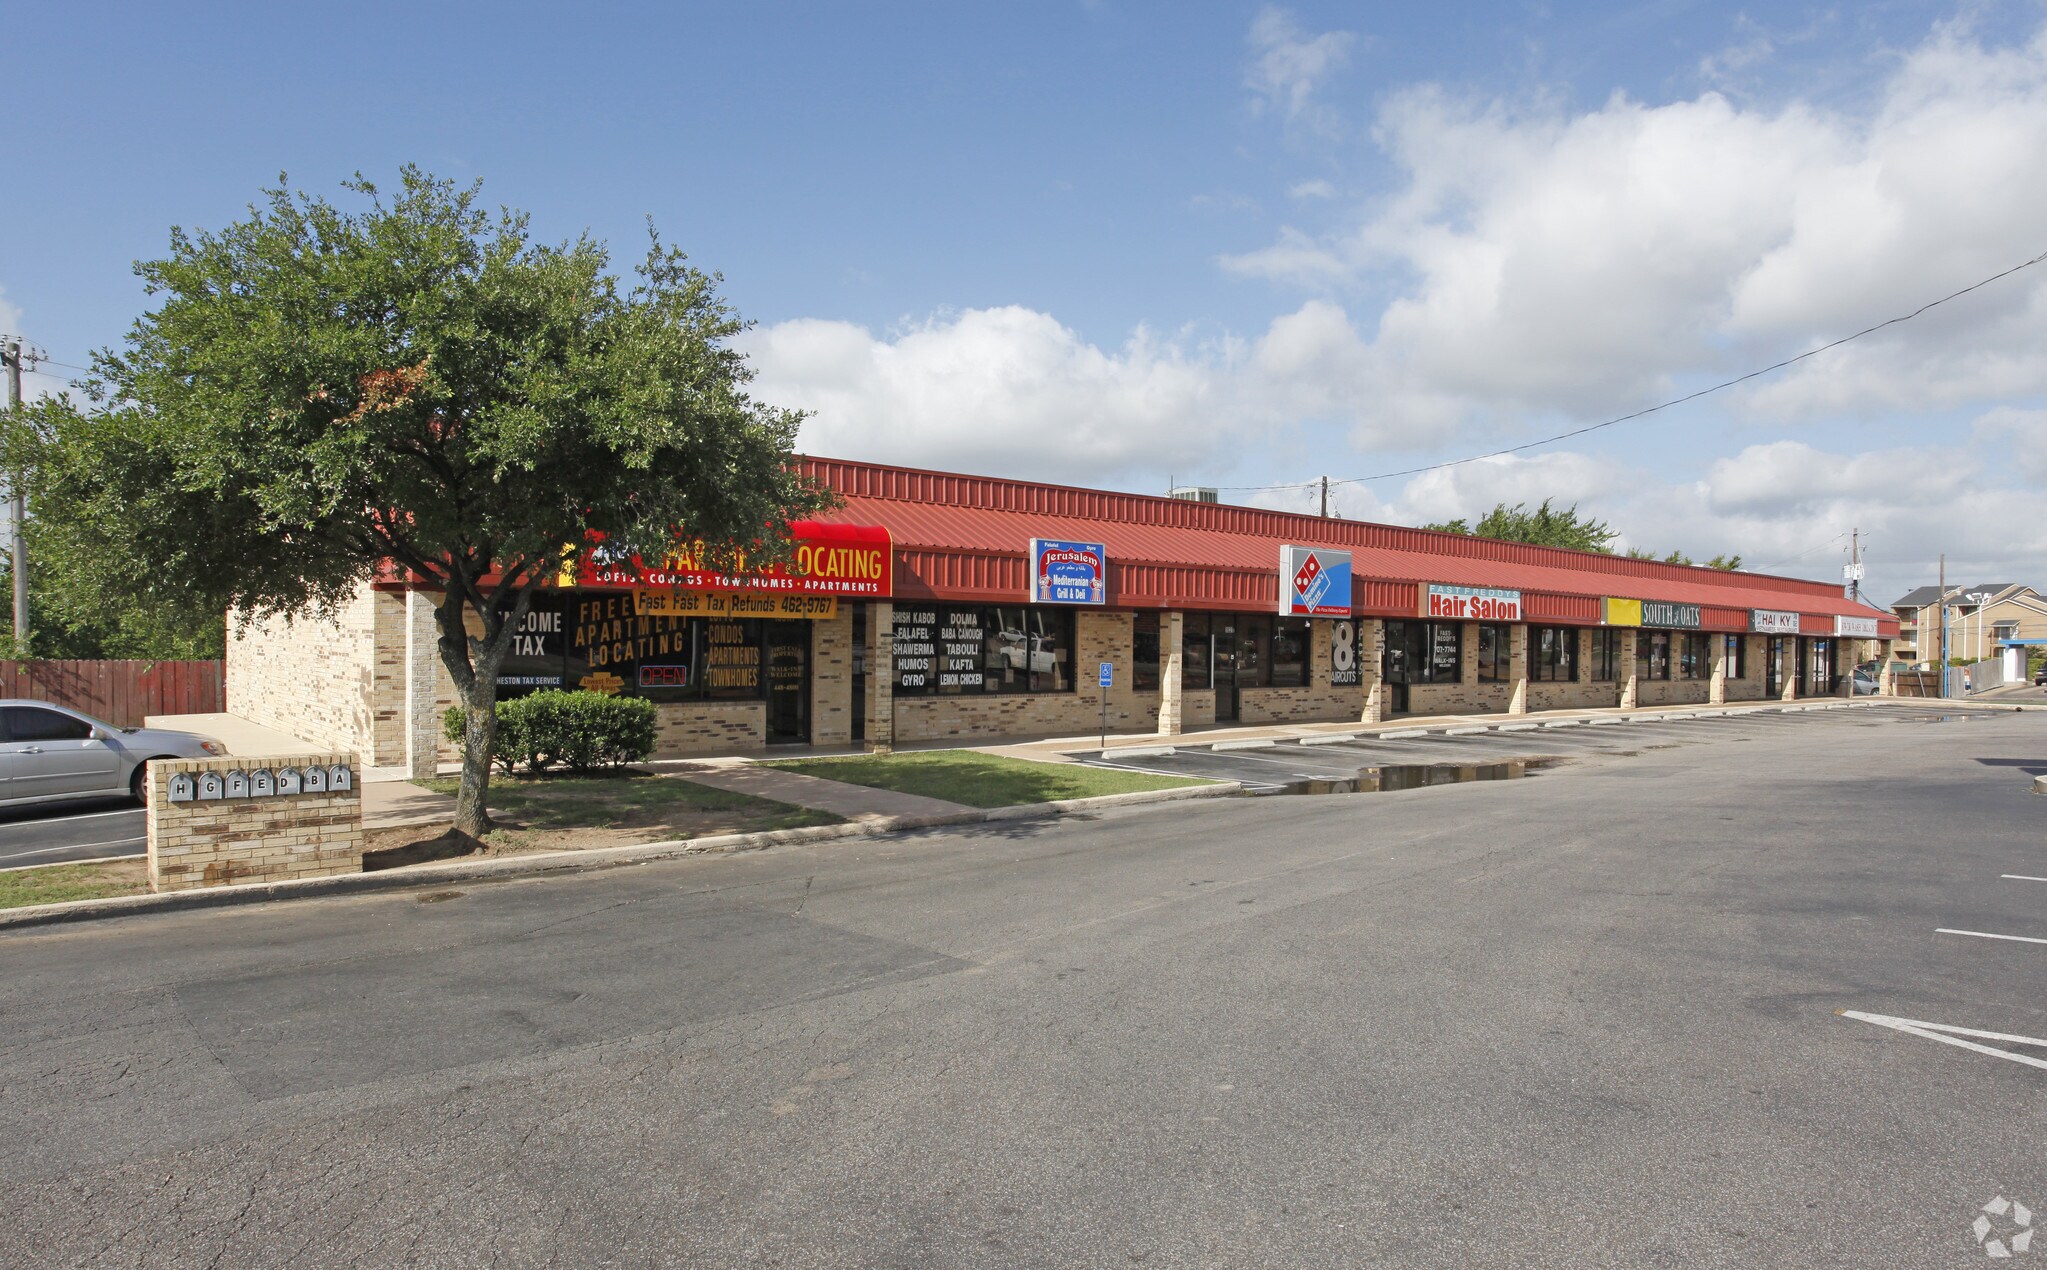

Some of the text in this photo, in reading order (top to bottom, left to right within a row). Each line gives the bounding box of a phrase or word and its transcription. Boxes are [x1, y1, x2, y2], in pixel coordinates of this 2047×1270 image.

[649, 573, 702, 585] CONOS
[715, 576, 793, 588] TOWHOMES
[804, 579, 878, 592] APARTMENTS
[1057, 587, 1069, 599] Grill
[1076, 588, 1086, 600] Deli
[1430, 584, 1519, 598] FAST FREDDYS
[638, 591, 666, 610] Fast
[673, 593, 699, 610] Fast
[706, 593, 726, 611] Tax
[731, 595, 776, 613] Refunds
[1430, 594, 1517, 620] Hair Salon
[580, 596, 630, 624] FREE
[1643, 603, 1700, 626] SOUTH OATS
[498, 611, 562, 632] COME
[892, 611, 936, 624] SHISH KABOB
[950, 613, 978, 625] DOLMA
[1762, 614, 1776, 626] HAI
[1780, 615, 1791, 627] KY
[709, 625, 744, 644] CONDOS
[898, 627, 930, 640] FALAFEL
[941, 628, 956, 640] BABA
[513, 635, 545, 656] TAX
[590, 632, 684, 668] LOCATING
[892, 643, 935, 655] SHAWERMA
[946, 643, 979, 655] TABOULI
[709, 646, 759, 666] APARTMENTS
[898, 658, 929, 670] HUMOS
[949, 658, 974, 671] KAFTA
[523, 677, 534, 685] TAX
[536, 677, 560, 686] SERVICE
[641, 668, 686, 686] OPEN
[709, 668, 758, 687] TOWNHOMES
[902, 674, 925, 687] GYRO
[940, 673, 983, 685] LEMON CHICKEN
[234, 780, 241, 791] F
[258, 778, 267, 789] E
[280, 778, 288, 788] D
[311, 775, 319, 786] B
[336, 774, 344, 784] A
[176, 783, 185, 794] H
[206, 782, 215, 793] G
